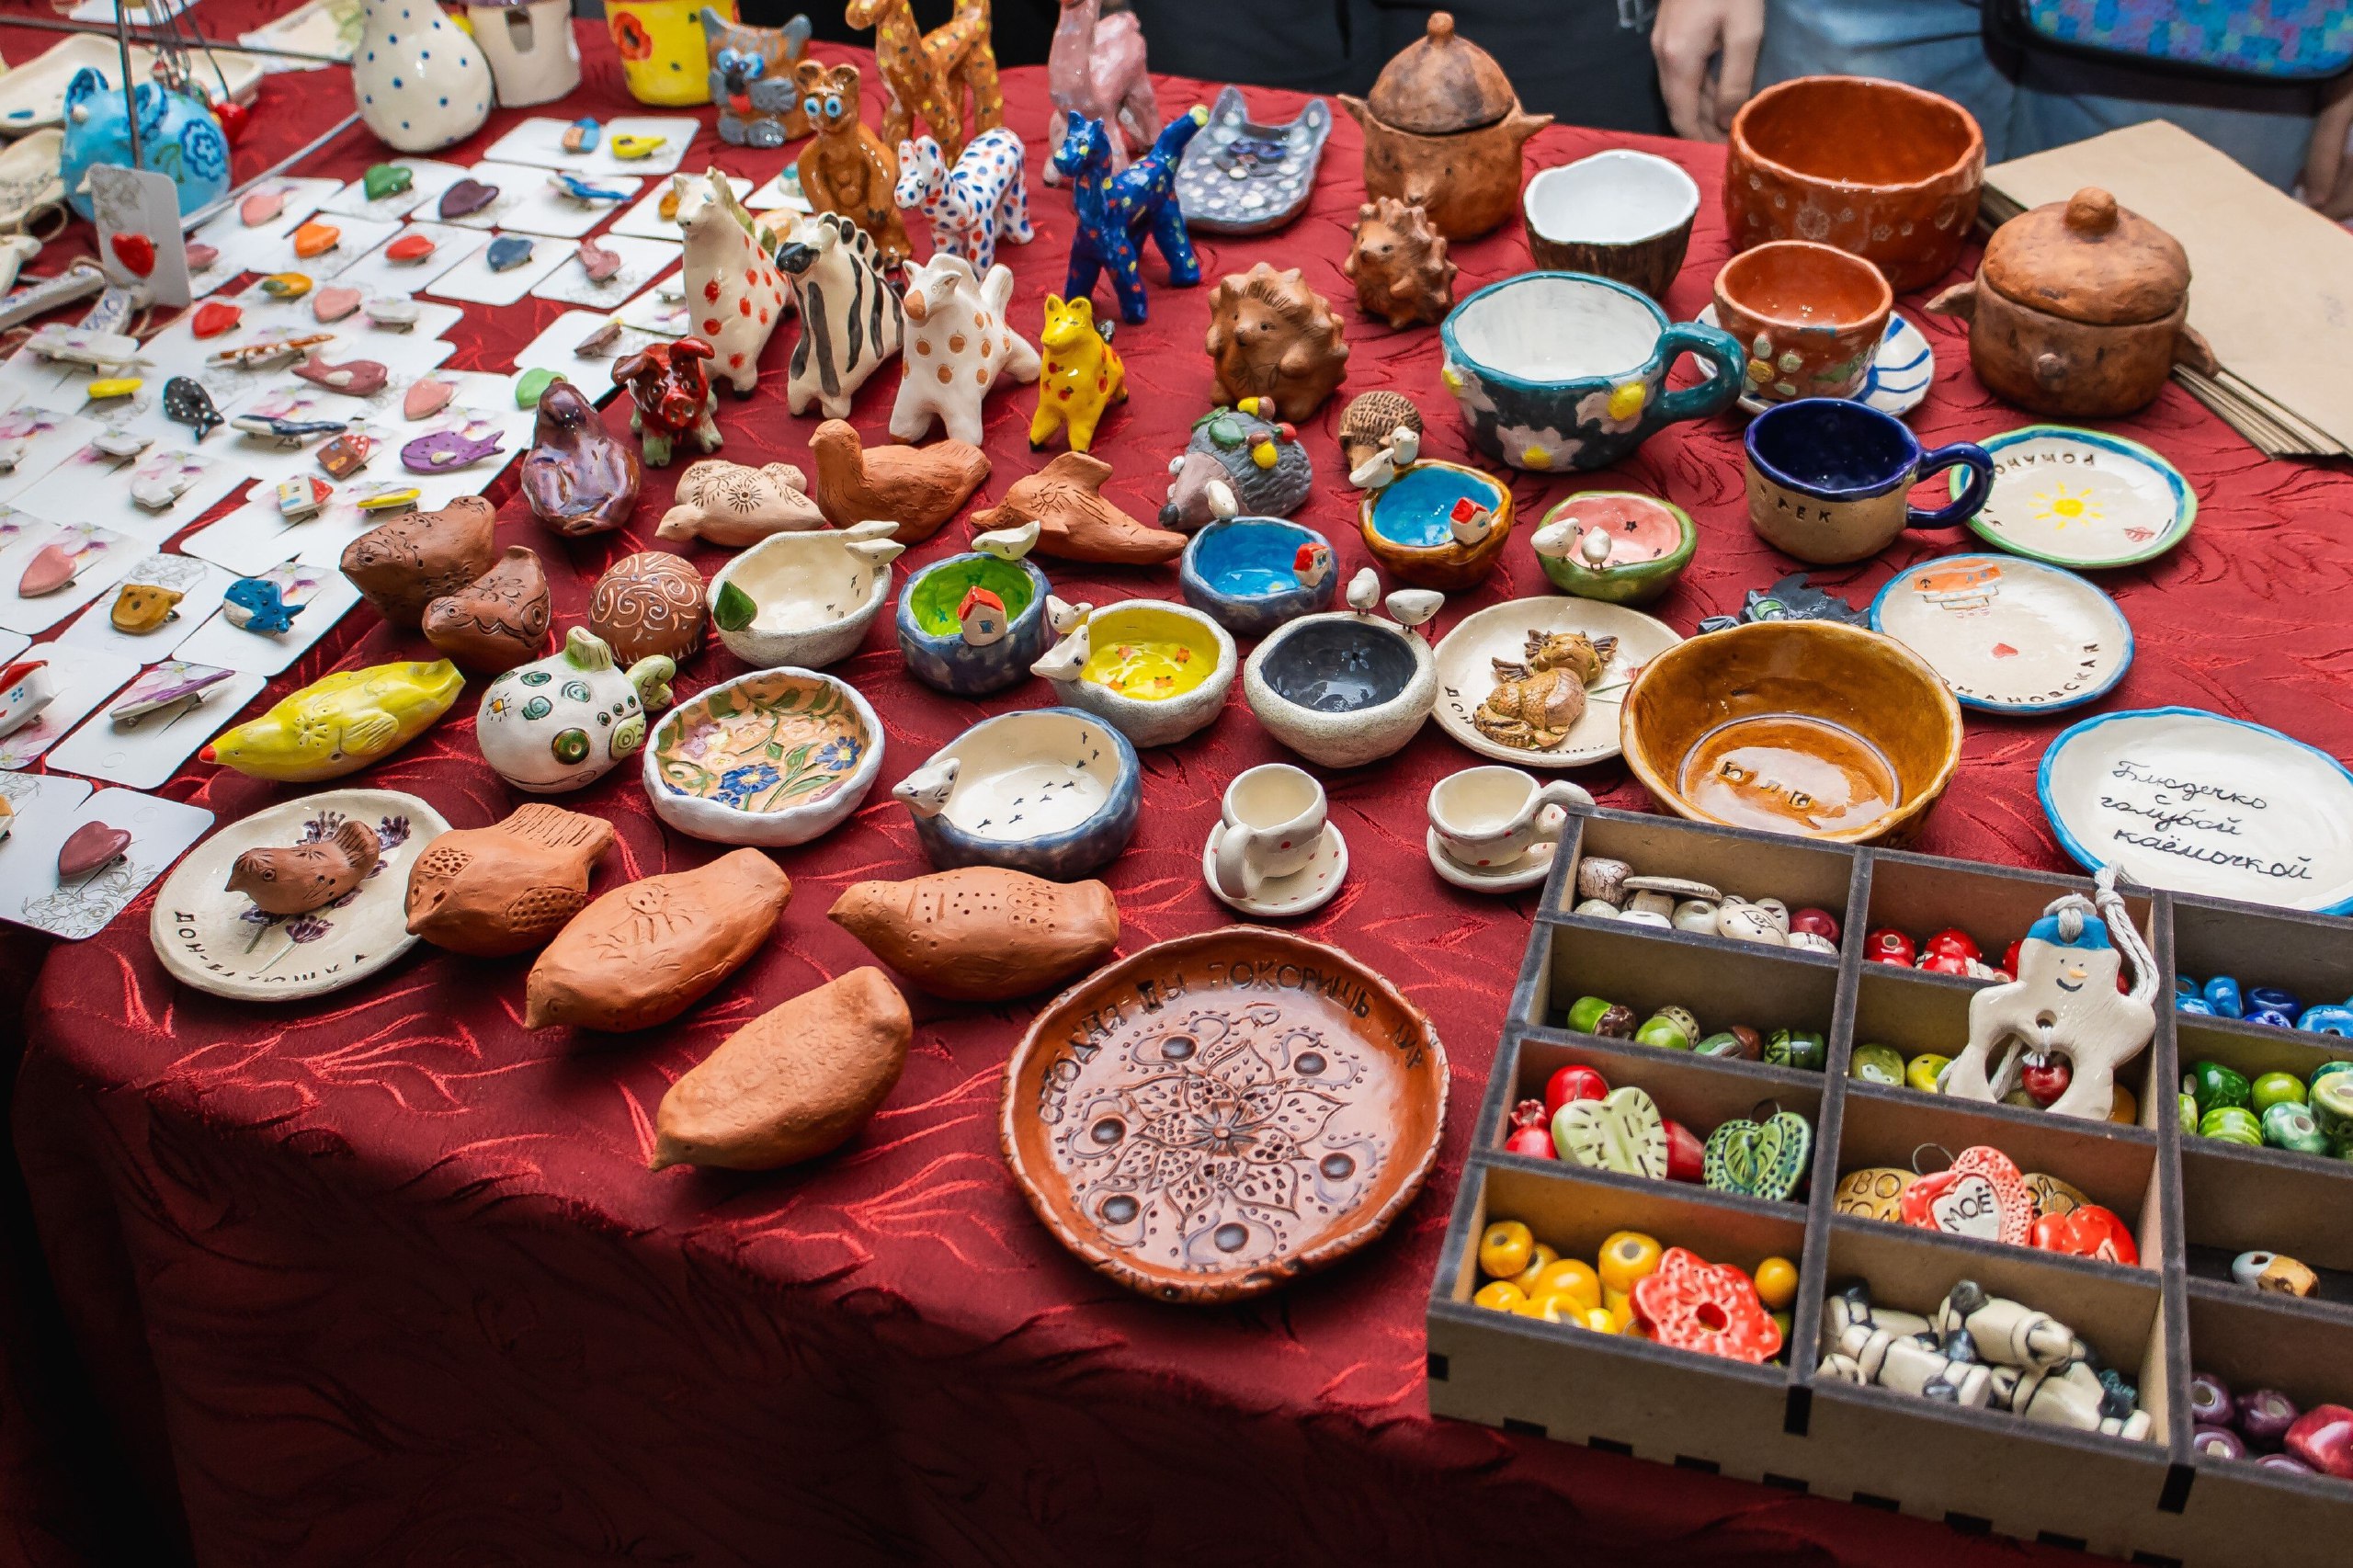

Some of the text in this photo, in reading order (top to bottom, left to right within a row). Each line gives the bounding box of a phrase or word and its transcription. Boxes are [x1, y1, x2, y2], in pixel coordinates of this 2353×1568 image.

[2112, 760, 2268, 810] Блюдечко
[2100, 795, 2243, 835] голубой
[2113, 828, 2313, 880] каёмочкой
[1943, 1183, 1994, 1232] МОЁ
